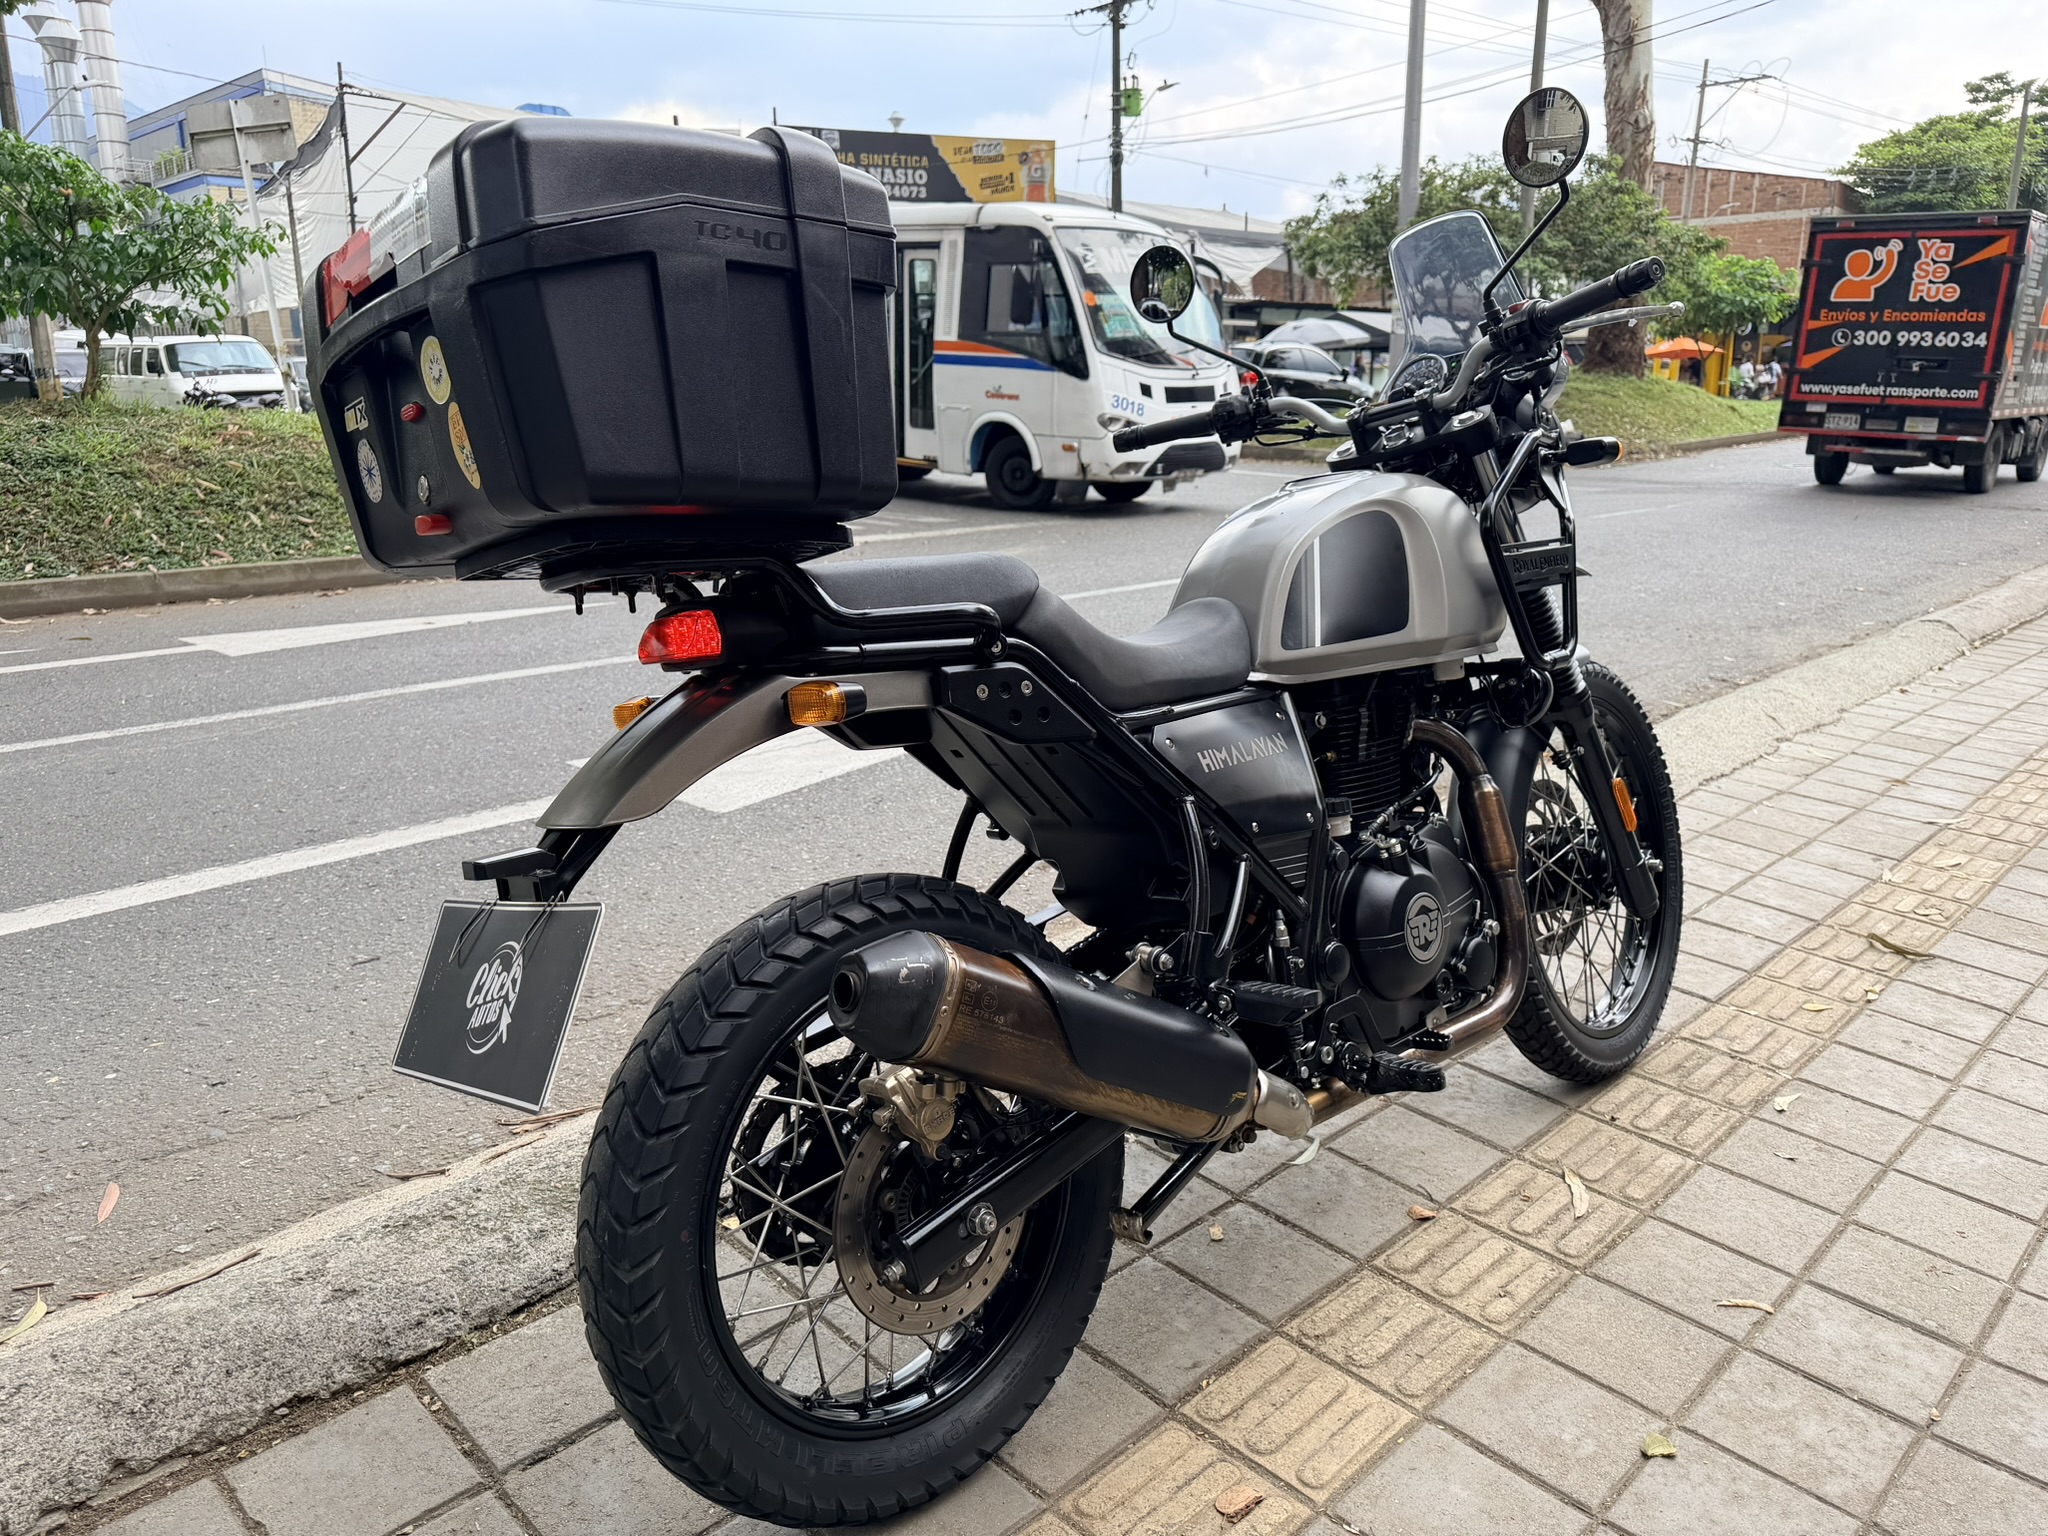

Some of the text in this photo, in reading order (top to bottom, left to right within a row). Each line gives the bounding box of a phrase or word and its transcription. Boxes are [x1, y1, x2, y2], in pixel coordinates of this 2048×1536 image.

[860, 152, 929, 168] SINTÉTICA
[868, 166, 928, 185] NASIO
[693, 220, 788, 251] TC40
[1917, 239, 1955, 261] Ya
[1912, 260, 1950, 282] Se
[1909, 280, 1960, 302] Fue
[1820, 308, 1986, 324] Envíos y Encomiendas
[1852, 330, 1891, 346] 300
[1111, 394, 1145, 417] 3018
[1512, 558, 1540, 573] ROYAL
[1196, 732, 1289, 773] HIMALAYAN
[467, 998, 504, 1030] AUTOS
